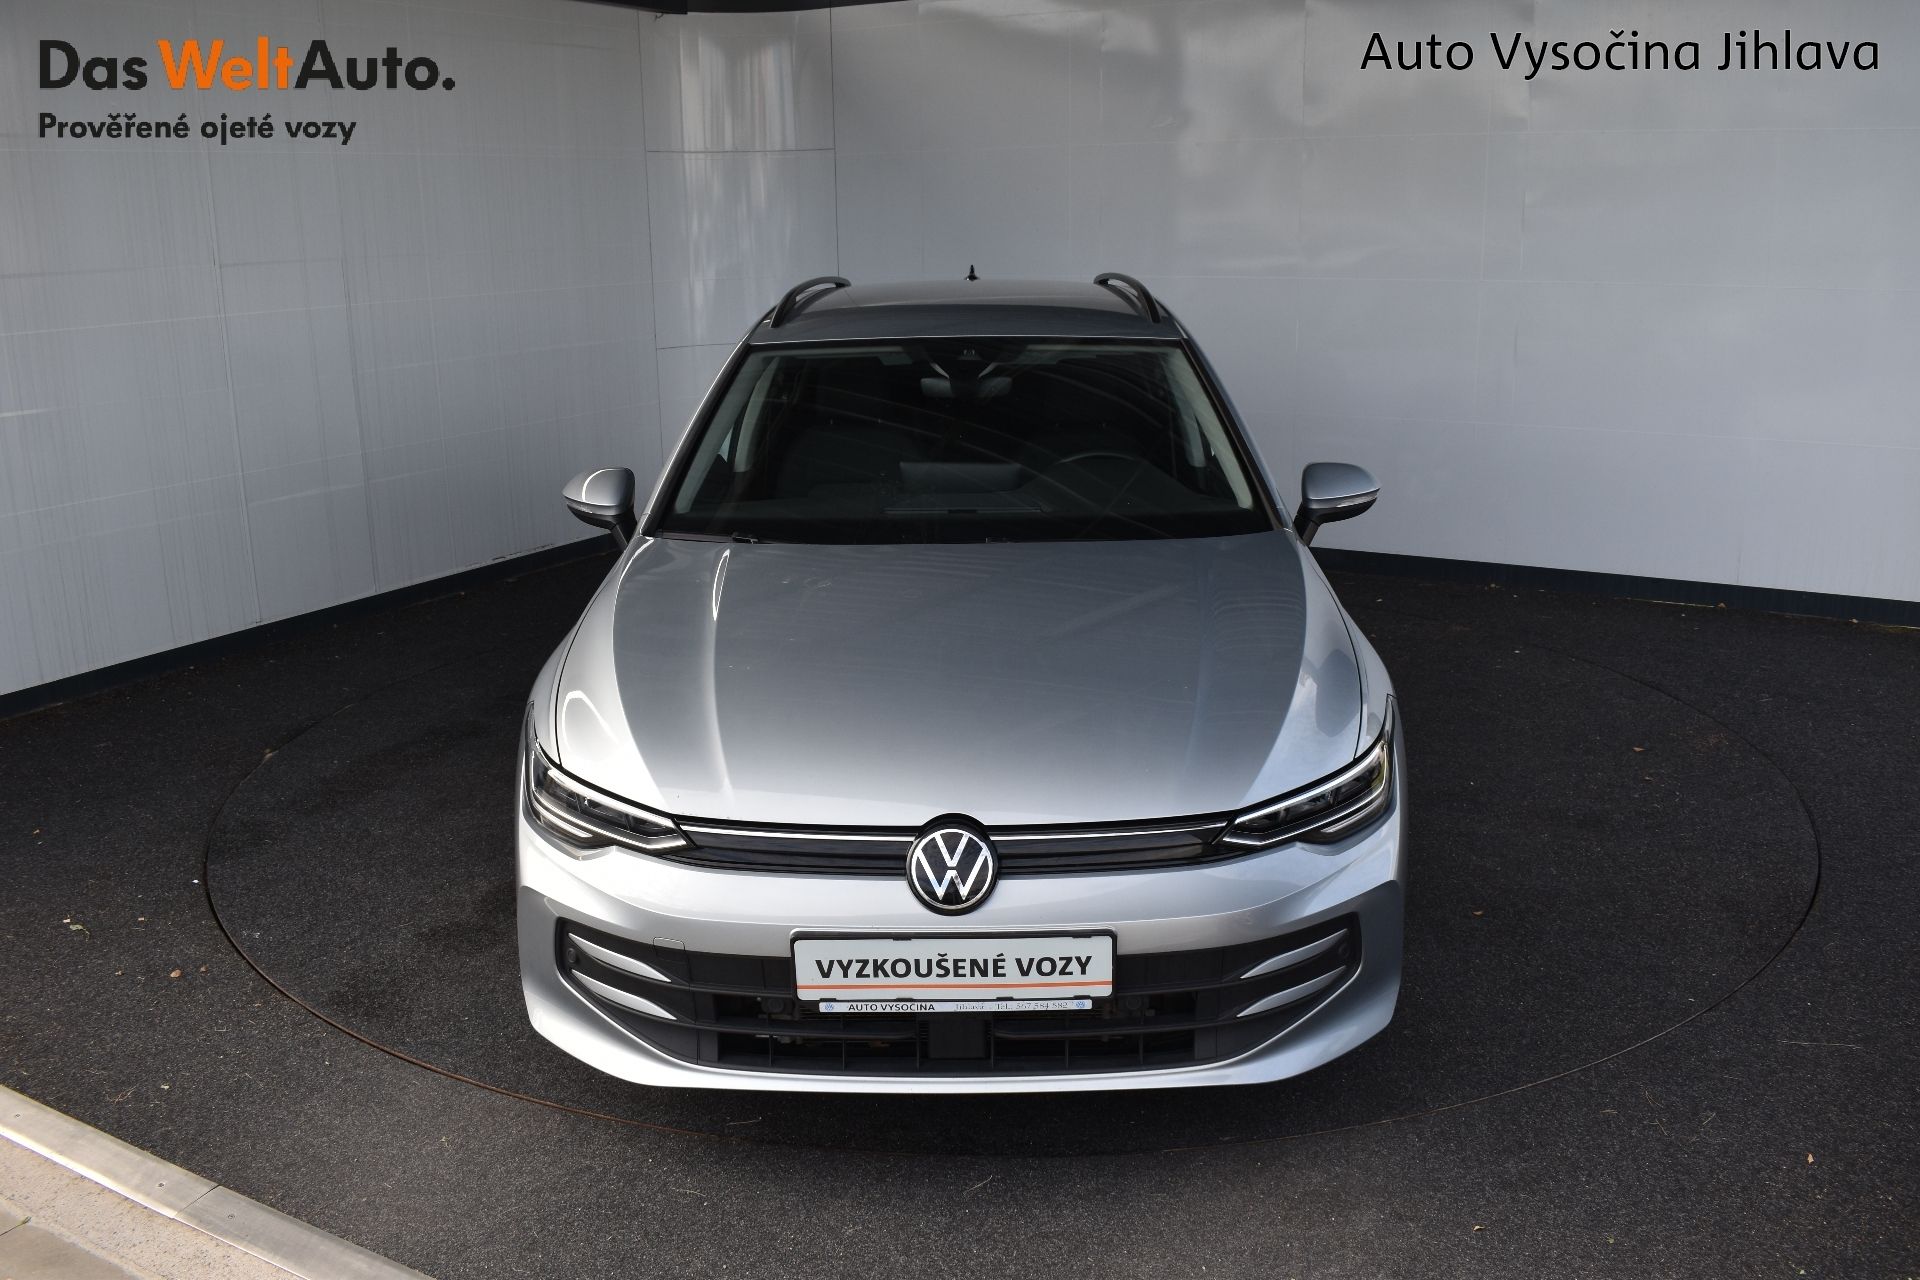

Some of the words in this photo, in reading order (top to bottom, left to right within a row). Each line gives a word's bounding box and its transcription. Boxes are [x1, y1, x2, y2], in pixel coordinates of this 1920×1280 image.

[815, 953, 1007, 979] VYZKOUŠENÉ
[1015, 955, 1093, 977] VOZY
[848, 1003, 878, 1011] AUTO
